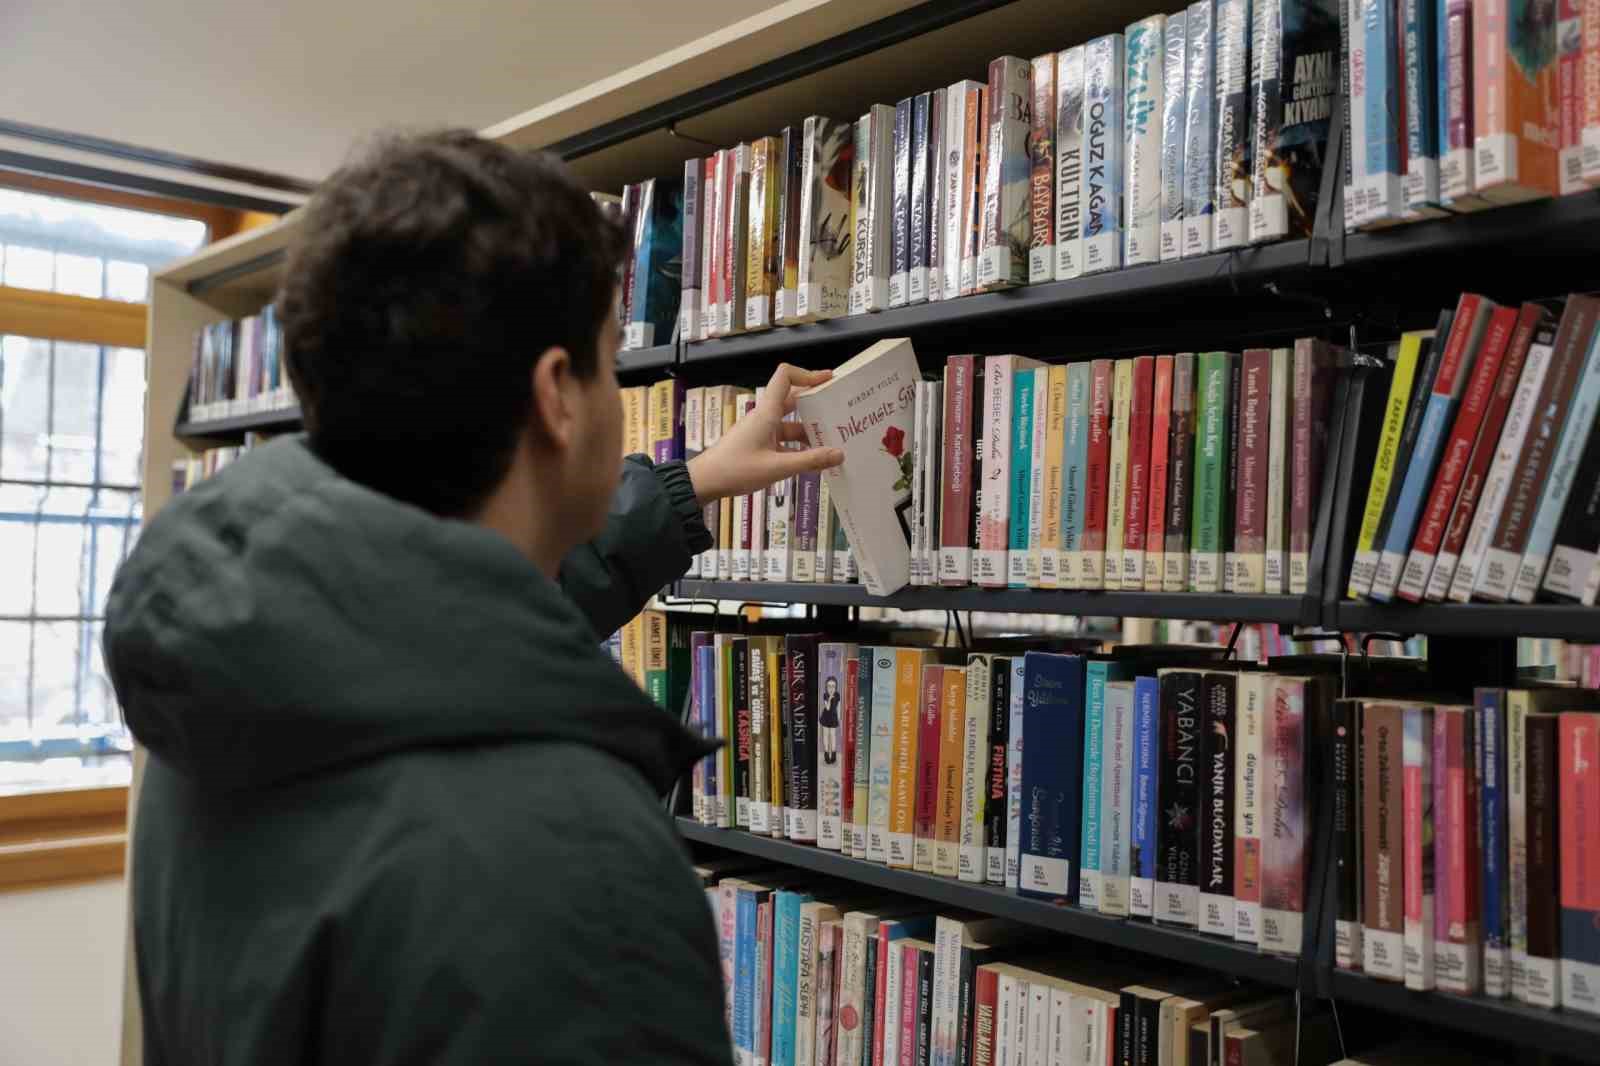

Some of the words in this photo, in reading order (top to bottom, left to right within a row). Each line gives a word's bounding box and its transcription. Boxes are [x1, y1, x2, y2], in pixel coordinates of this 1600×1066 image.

[1089, 102, 1106, 161] OĞUZ
[1222, 106, 1236, 149] KORAY
[1087, 167, 1106, 237] KAĞAN
[899, 380, 916, 413] Gü
[991, 387, 1001, 425] BEBEK
[748, 648, 761, 683] SAVAŞ
[1091, 678, 1103, 699] Ben
[1140, 691, 1152, 728] NERMİN
[751, 698, 761, 735] GURUR
[899, 701, 911, 730] SARI
[1175, 688, 1195, 784] YABANCI
[990, 744, 1007, 799] FIRTINA
[1211, 752, 1225, 796] YANIK
[1243, 752, 1257, 808] dünyanın
[1209, 798, 1227, 887] BUĞDAYLAR
[1241, 813, 1255, 835] yan
[800, 917, 813, 977] MUSTAFA
